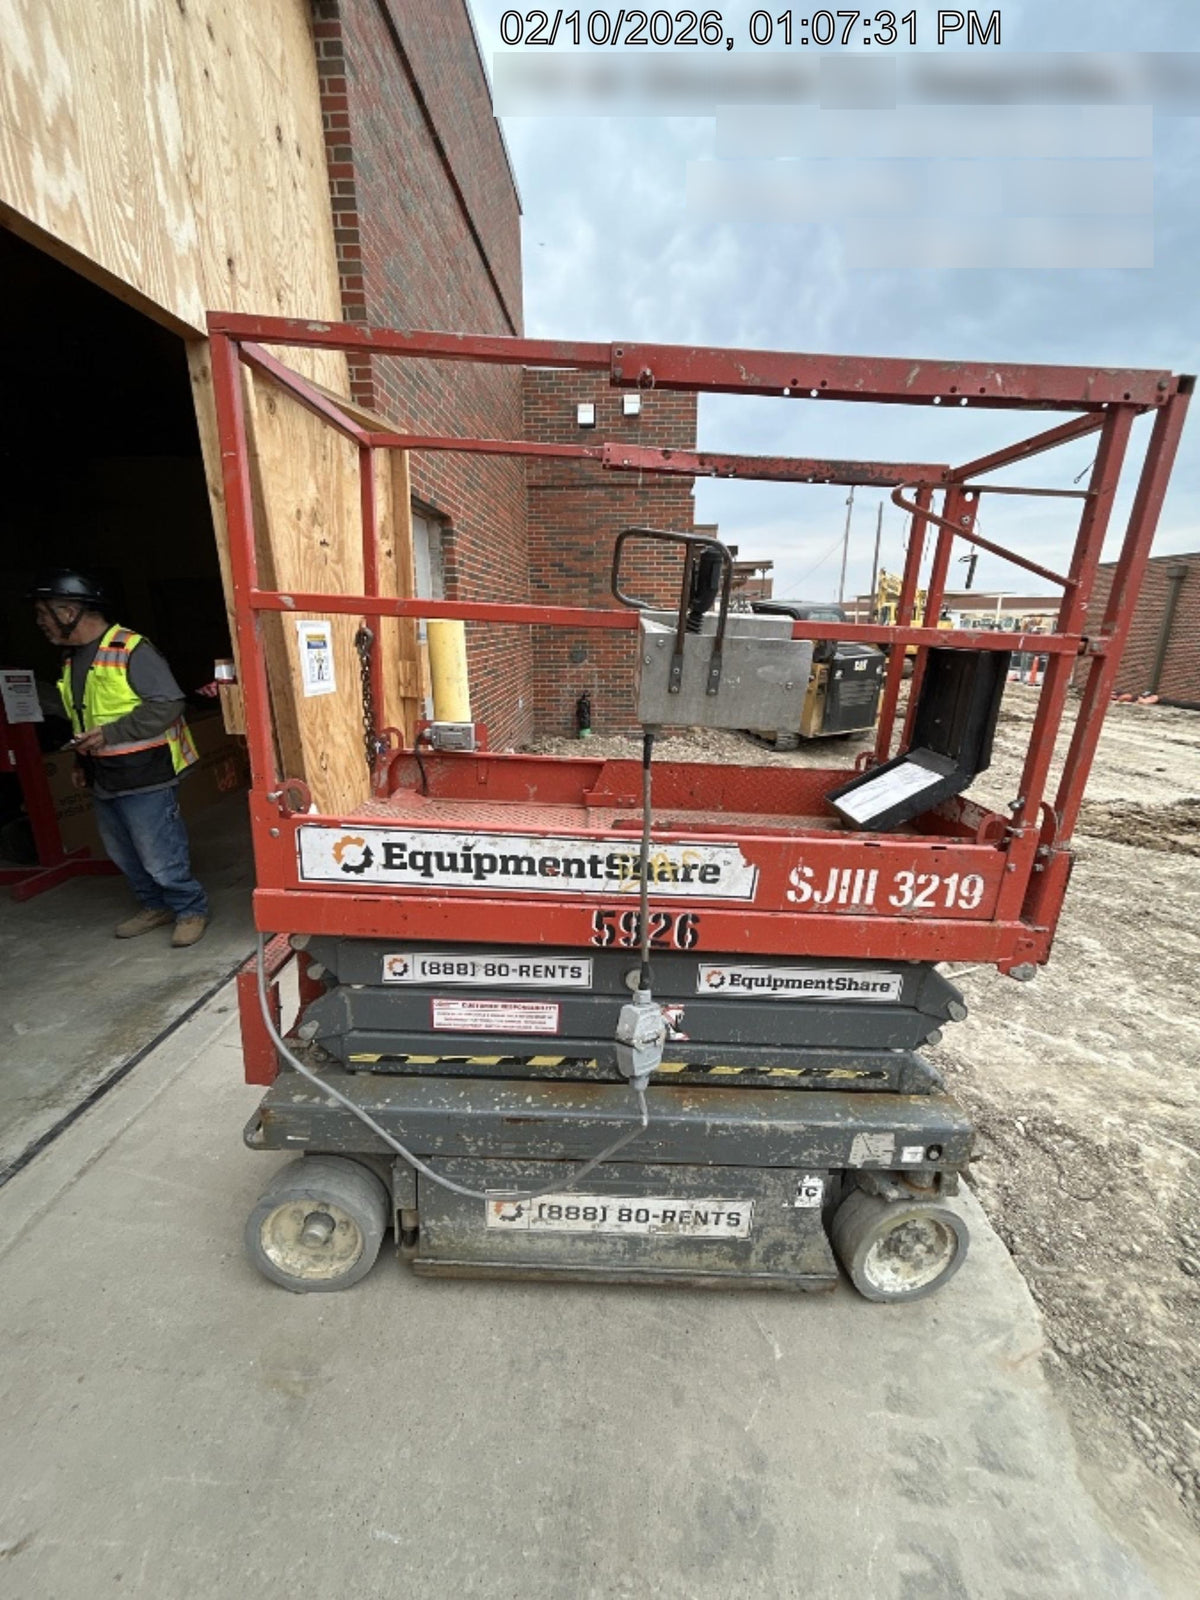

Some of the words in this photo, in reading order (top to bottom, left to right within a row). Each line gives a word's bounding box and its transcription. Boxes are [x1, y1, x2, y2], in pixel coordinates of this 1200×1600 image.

[381, 841, 721, 885] EquipmentShare
[888, 870, 985, 910] 3219
[591, 909, 700, 949] 5926
[484, 962, 582, 979] 80-RENTS
[728, 973, 892, 993] EquipmentShare
[617, 1207, 741, 1227] 80-RENTS
